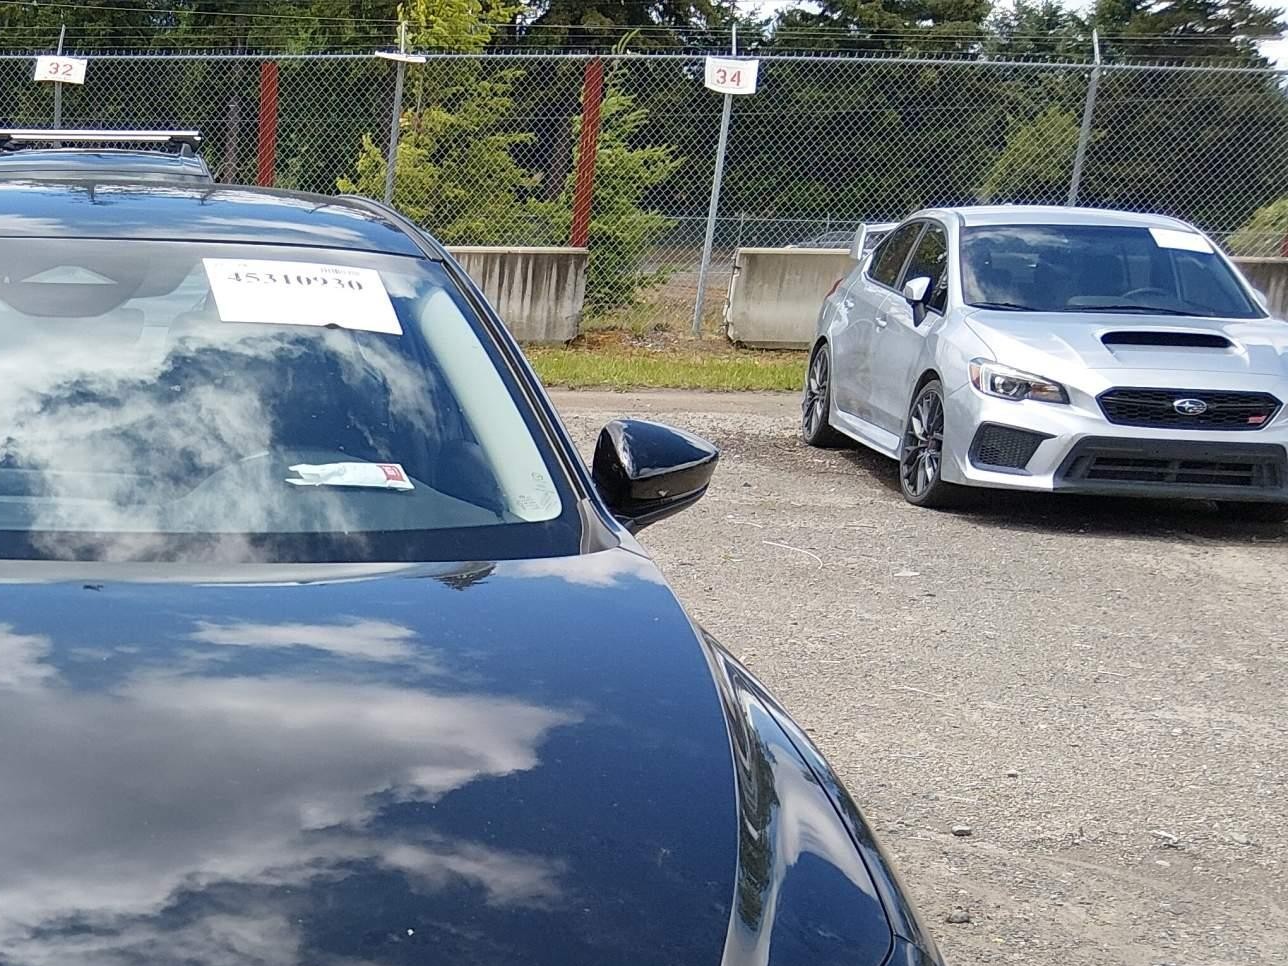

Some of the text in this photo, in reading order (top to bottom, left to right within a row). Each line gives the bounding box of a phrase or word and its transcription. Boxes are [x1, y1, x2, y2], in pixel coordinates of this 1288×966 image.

[48, 61, 74, 77] 32
[715, 67, 742, 87] 34
[226, 271, 365, 292] 45310930
